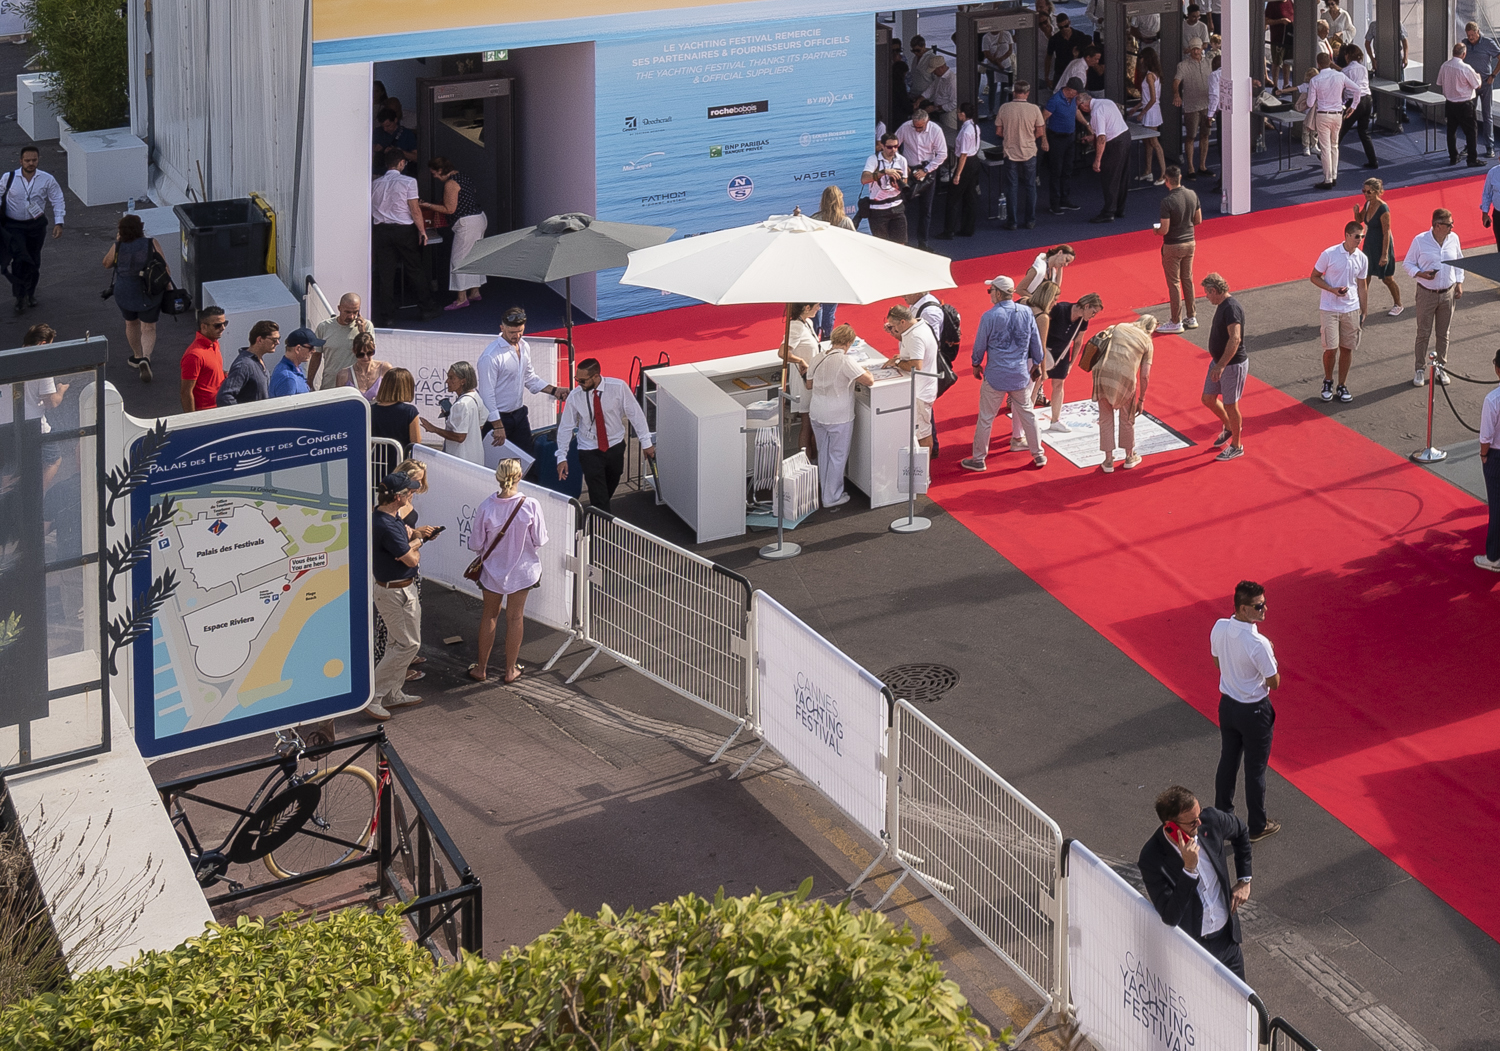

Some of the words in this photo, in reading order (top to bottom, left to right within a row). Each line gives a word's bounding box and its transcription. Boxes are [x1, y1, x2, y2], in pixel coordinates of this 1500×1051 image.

[631, 57, 650, 67] SES
[652, 50, 719, 64] PARTENAIRES
[721, 48, 728, 57] &
[730, 40, 802, 56] FOURNISSEURS
[803, 35, 851, 48] OFFICIELS
[663, 43, 676, 53] LE
[678, 38, 727, 50] YACHTING
[729, 33, 773, 46] FESTIVAL
[775, 28, 822, 41] REMERCIE
[635, 70, 655, 81] THE
[656, 65, 703, 78] YACHTING
[704, 60, 746, 73] FESTIVAL
[749, 55, 785, 67] THANKS
[786, 53, 801, 63] ITS
[801, 48, 848, 61] PARTNERS
[692, 75, 700, 84] &
[702, 71, 744, 83] OFFICIAL
[745, 64, 794, 78] SUPPLIERS
[725, 143, 739, 151] BNP
[740, 139, 770, 148] PARIBAS
[793, 170, 836, 181] WAJER
[641, 190, 687, 203] FATHOM
[148, 461, 187, 474] PALAIS
[209, 447, 263, 463] FESTIVALS
[296, 431, 348, 447] CONGRÈS
[309, 443, 348, 457] Cannes
[196, 547, 218, 558] Palais
[219, 545, 232, 553] des
[233, 537, 265, 550] Festivals
[203, 622, 229, 633] Espace
[229, 616, 255, 627] Riviera
[796, 671, 839, 718] CANNES
[793, 683, 844, 740] YACHTING
[795, 703, 843, 758] FESTIVAL
[1125, 951, 1188, 1018] CANNES
[1120, 963, 1195, 1047] YACHTING
